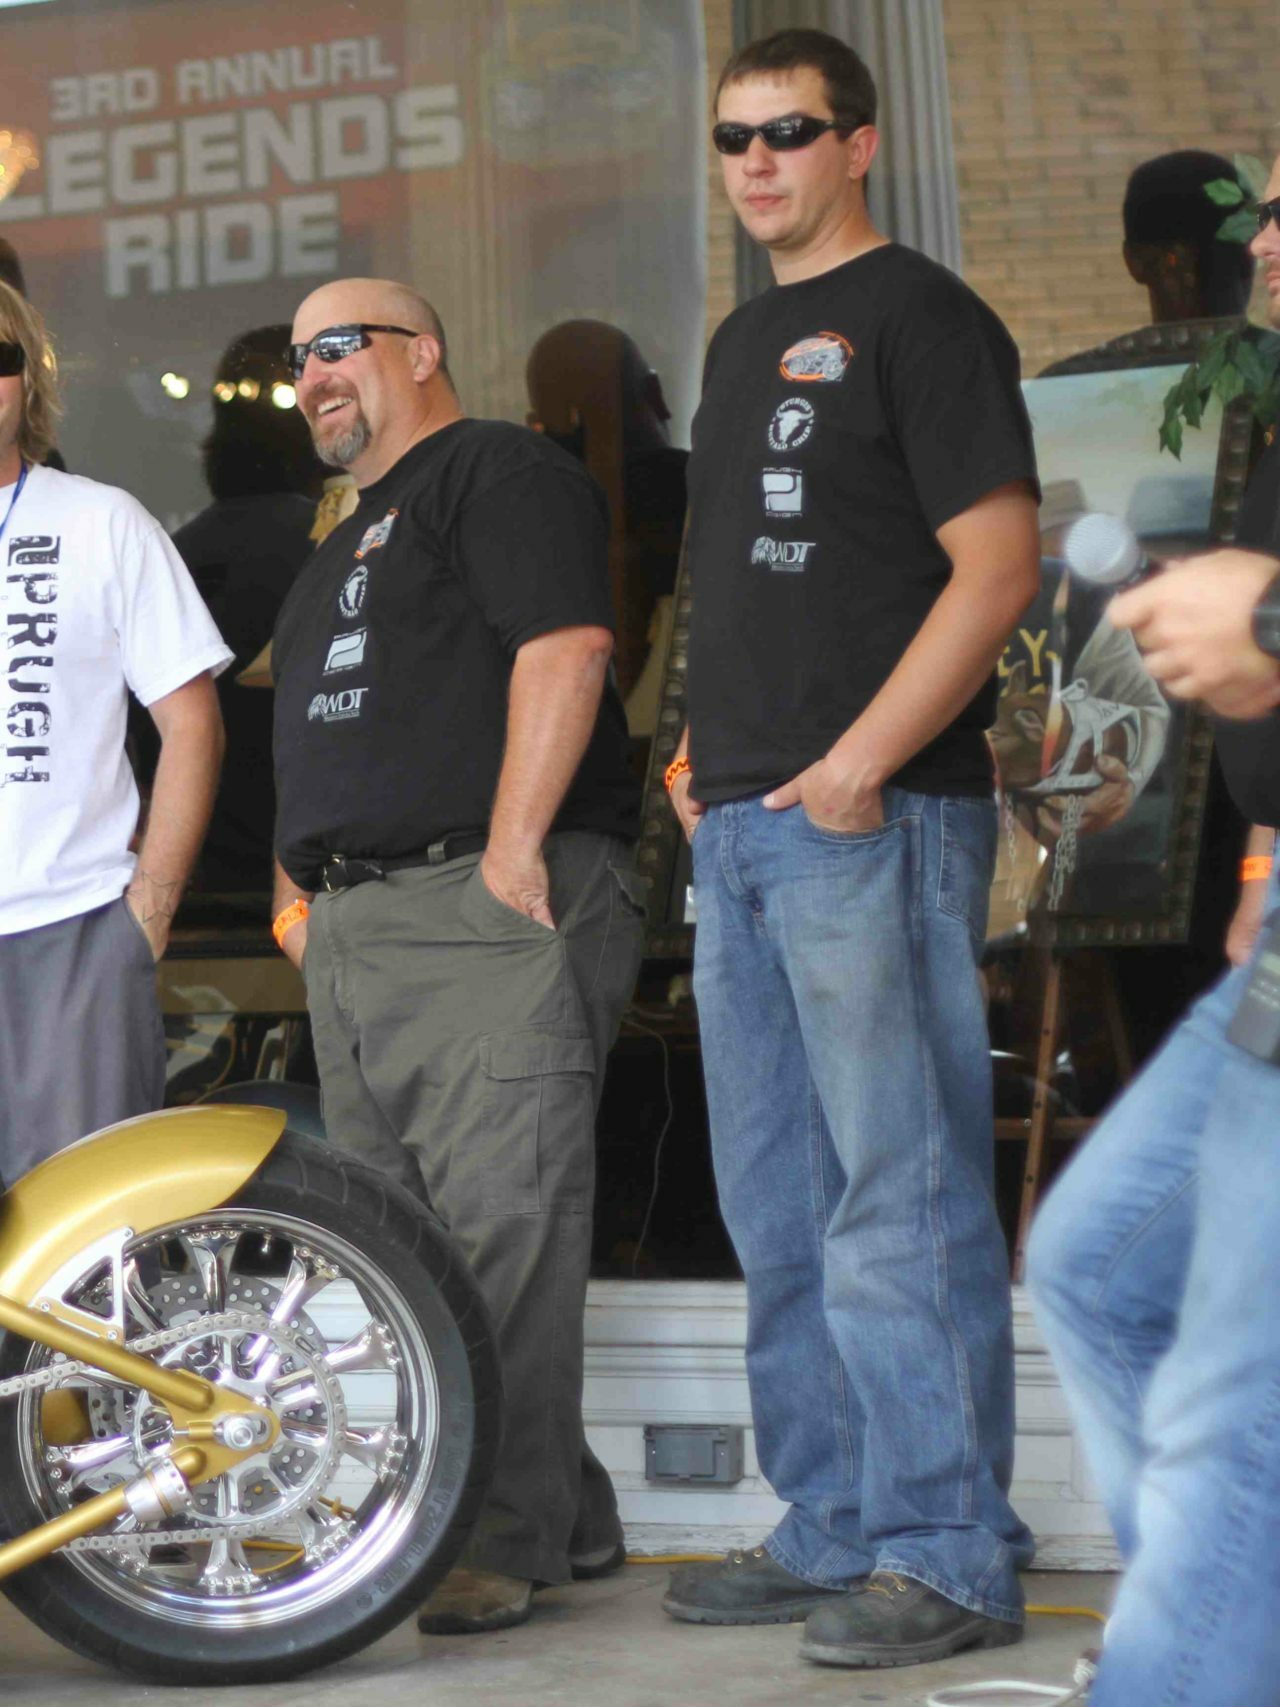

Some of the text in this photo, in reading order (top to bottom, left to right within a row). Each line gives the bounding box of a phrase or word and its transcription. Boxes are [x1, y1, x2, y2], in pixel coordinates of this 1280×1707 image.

[49, 36, 399, 123] 3RD ANNUAL
[106, 192, 340, 298] RIDE
[6, 573, 58, 782] PRUGH
[323, 687, 369, 714] WDT
